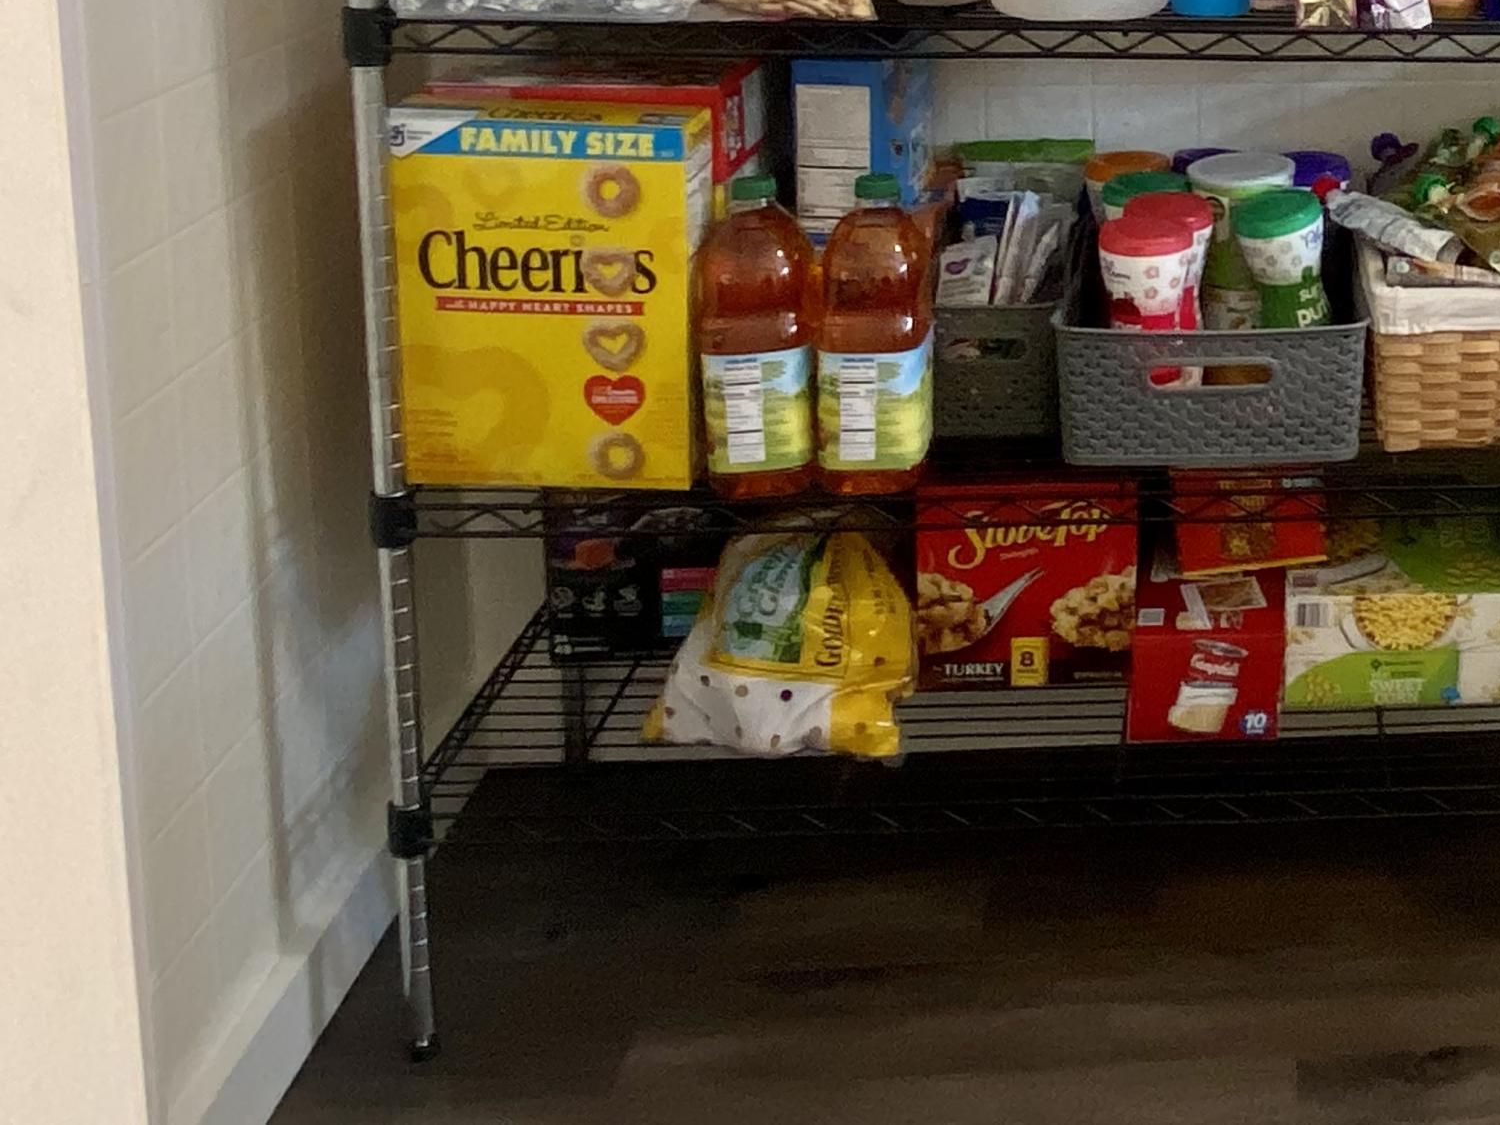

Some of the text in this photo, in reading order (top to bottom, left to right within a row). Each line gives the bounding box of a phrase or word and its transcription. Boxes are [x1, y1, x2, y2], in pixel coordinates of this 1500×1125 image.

[460, 127, 577, 155] FAMILY
[586, 132, 656, 158] SIZE
[472, 211, 610, 233] Limited Edition
[467, 300, 517, 312] HAPPY
[521, 302, 570, 314] HEART
[576, 303, 633, 315] SHAPES
[1019, 650, 1035, 668] 8
[944, 661, 1004, 676] TURKEY
[1244, 712, 1267, 729] 10
